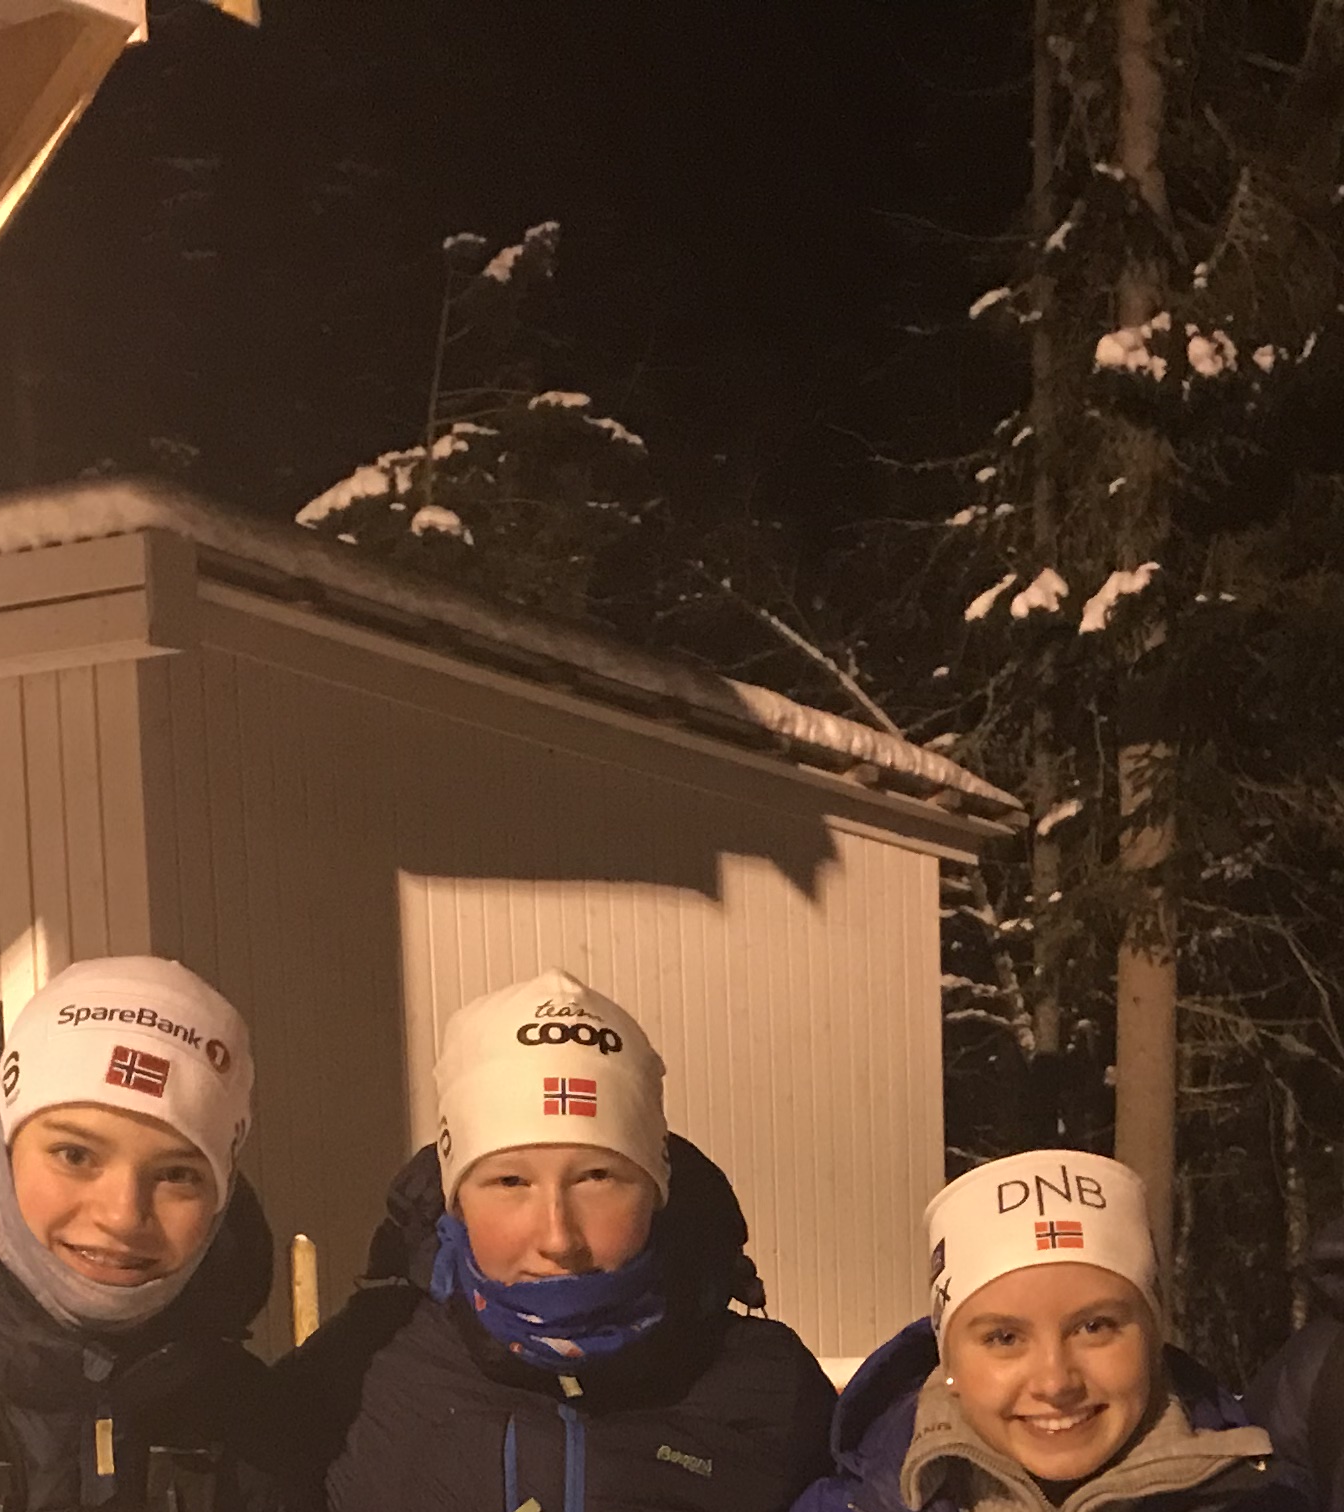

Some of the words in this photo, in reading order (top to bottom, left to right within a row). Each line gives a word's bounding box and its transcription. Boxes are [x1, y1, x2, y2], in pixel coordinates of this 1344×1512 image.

[57, 1003, 203, 1050] SpareBank
[535, 999, 605, 1022] team
[997, 1165, 1106, 1216] DNB
